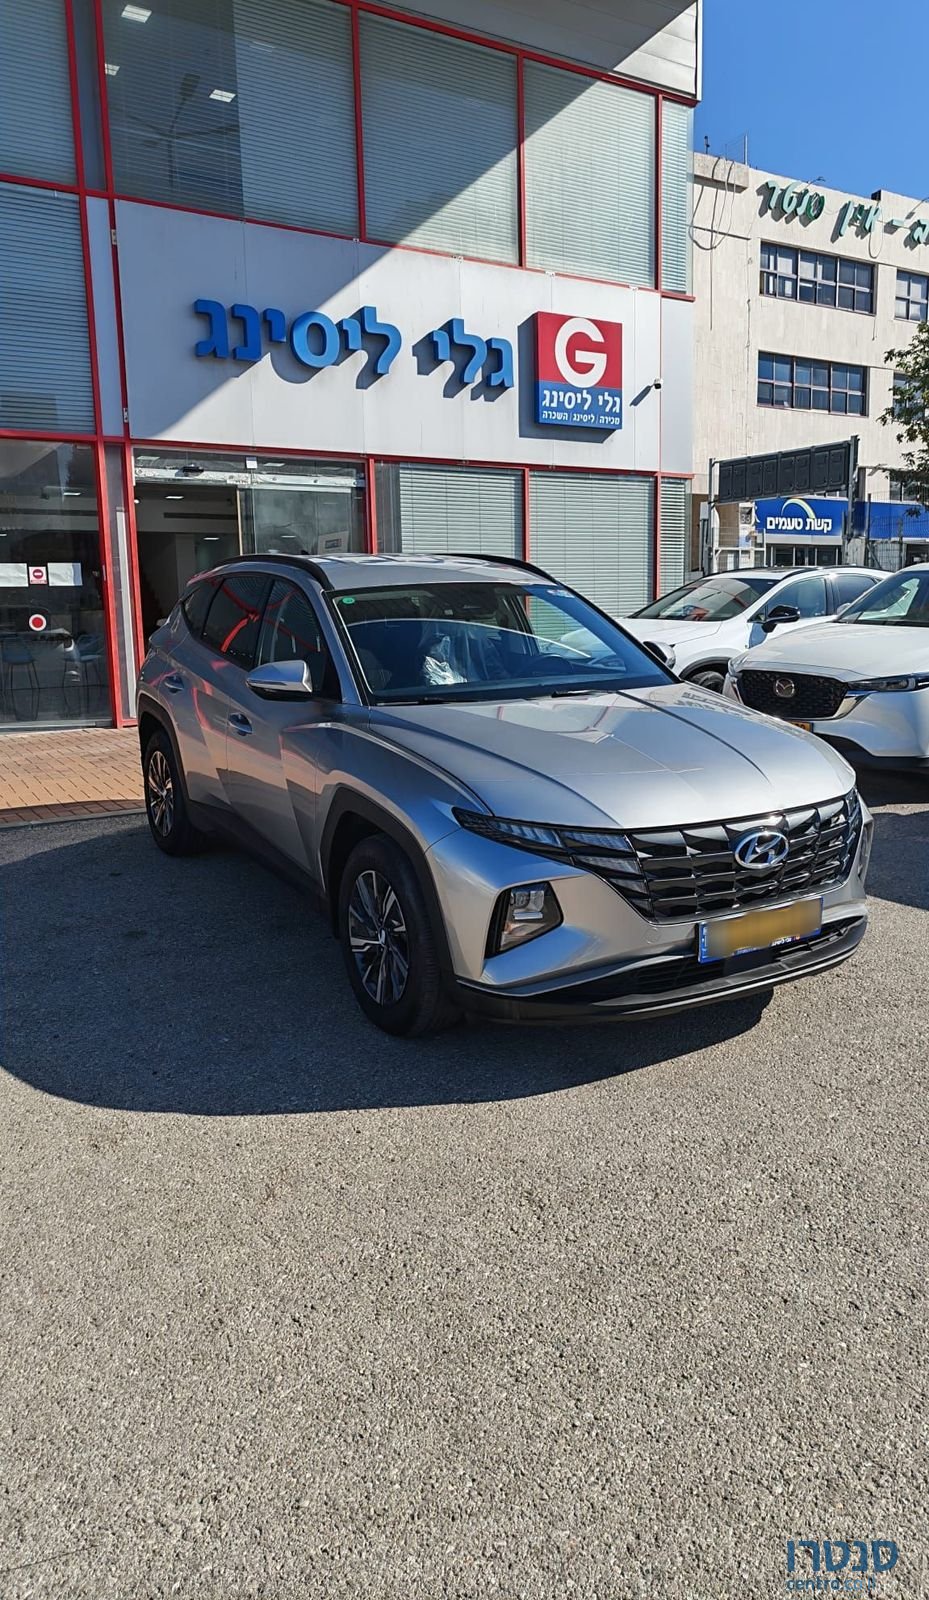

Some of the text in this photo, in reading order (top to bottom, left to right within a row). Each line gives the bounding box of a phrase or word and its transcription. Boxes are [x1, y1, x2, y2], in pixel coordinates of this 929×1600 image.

[194, 298, 514, 388] גלי ליסינג
[554, 316, 607, 389] G
[542, 389, 621, 414] גלי ליסינג
[542, 410, 620, 425] מכירה ליסינג השכרה
[766, 516, 833, 534] קשת טעמים
